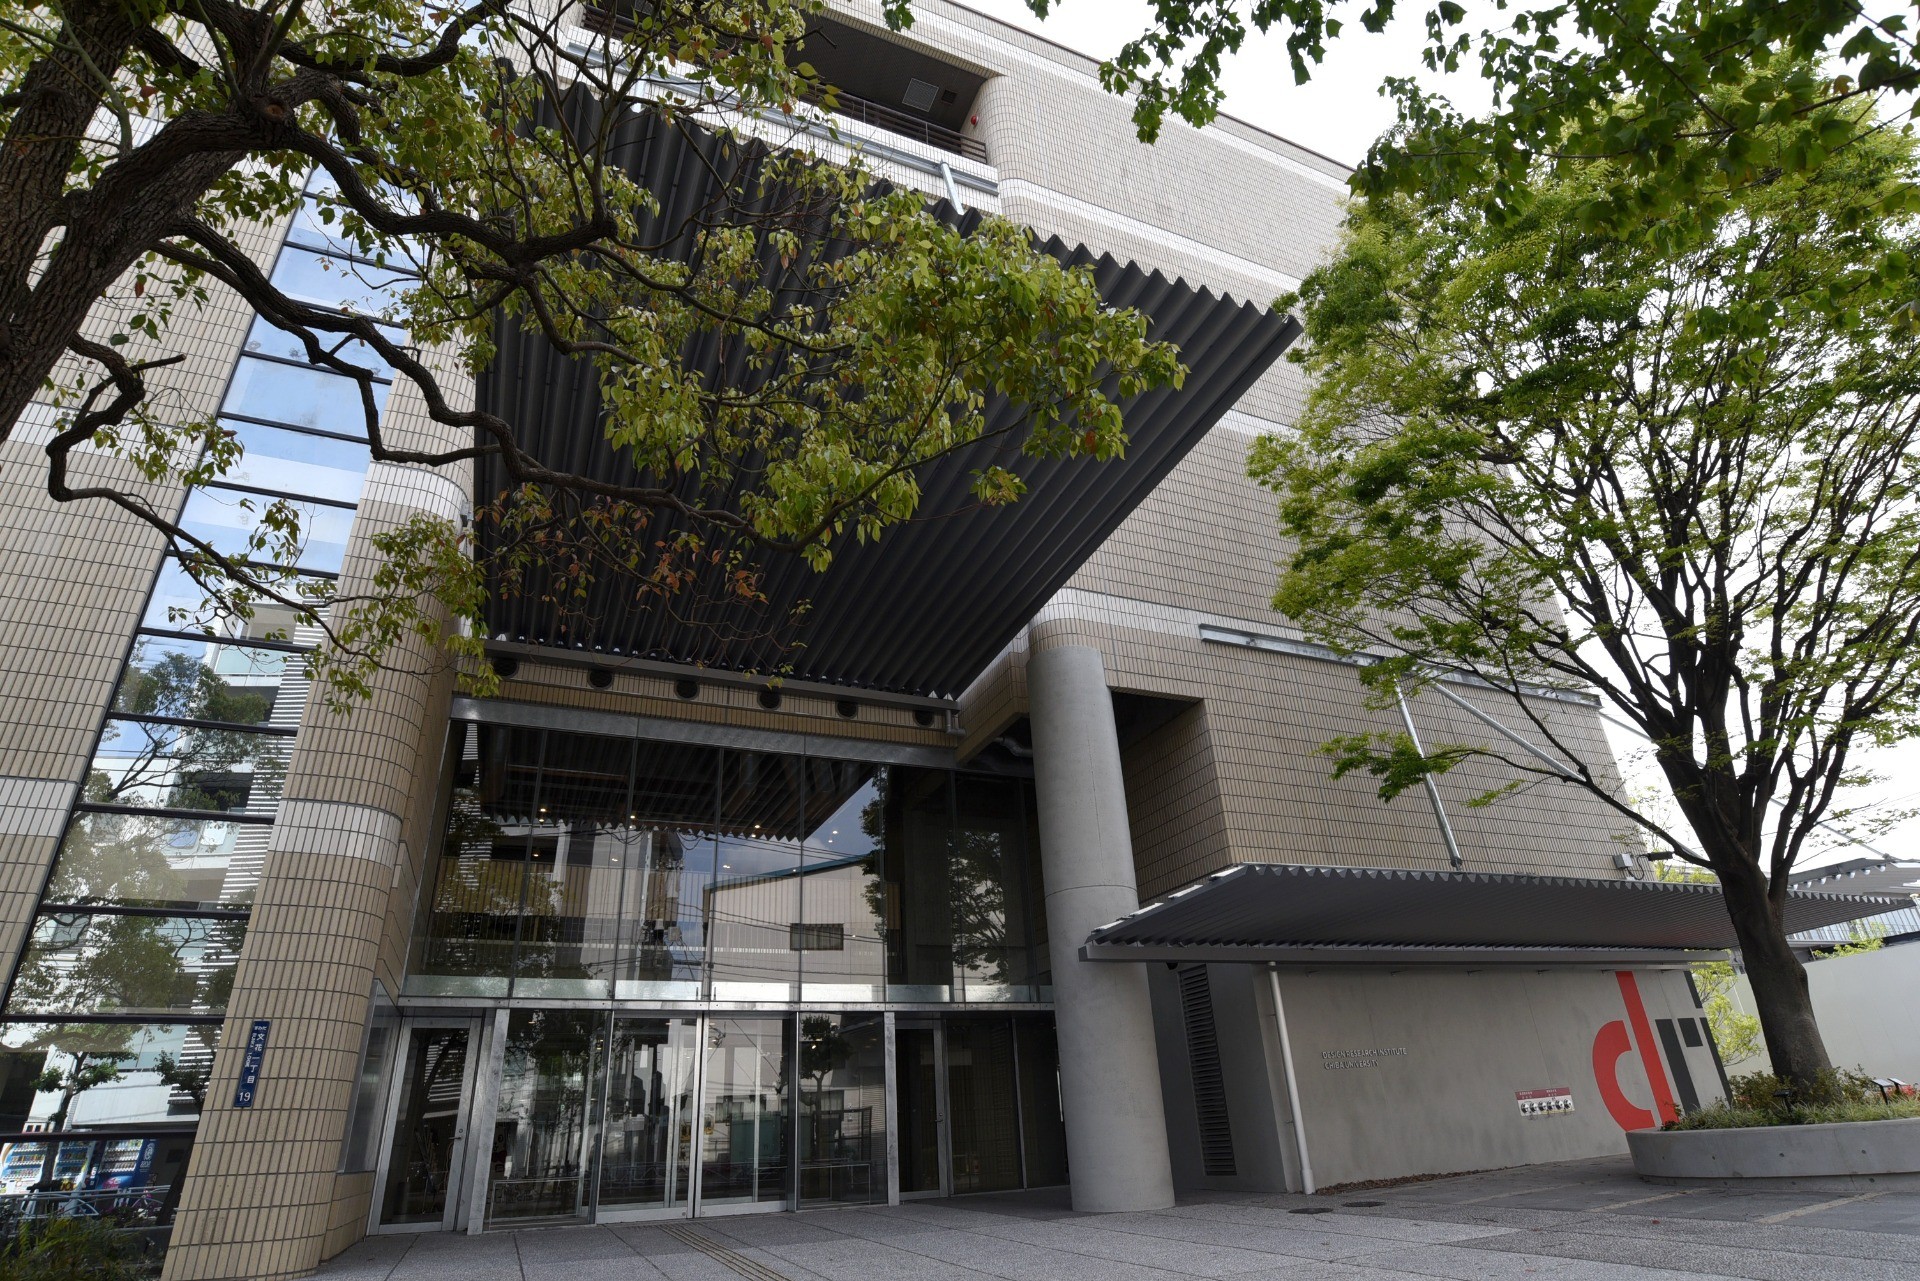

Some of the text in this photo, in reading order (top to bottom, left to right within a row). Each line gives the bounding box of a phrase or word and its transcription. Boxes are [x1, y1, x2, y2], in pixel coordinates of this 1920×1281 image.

[247, 1033, 265, 1084] 文花一丁目
[1322, 1047, 1407, 1060] DESIGN RESEARCH INSTITUTE
[1324, 1059, 1379, 1070] CHIBA UNIVERSITY
[239, 1092, 251, 1102] 19
